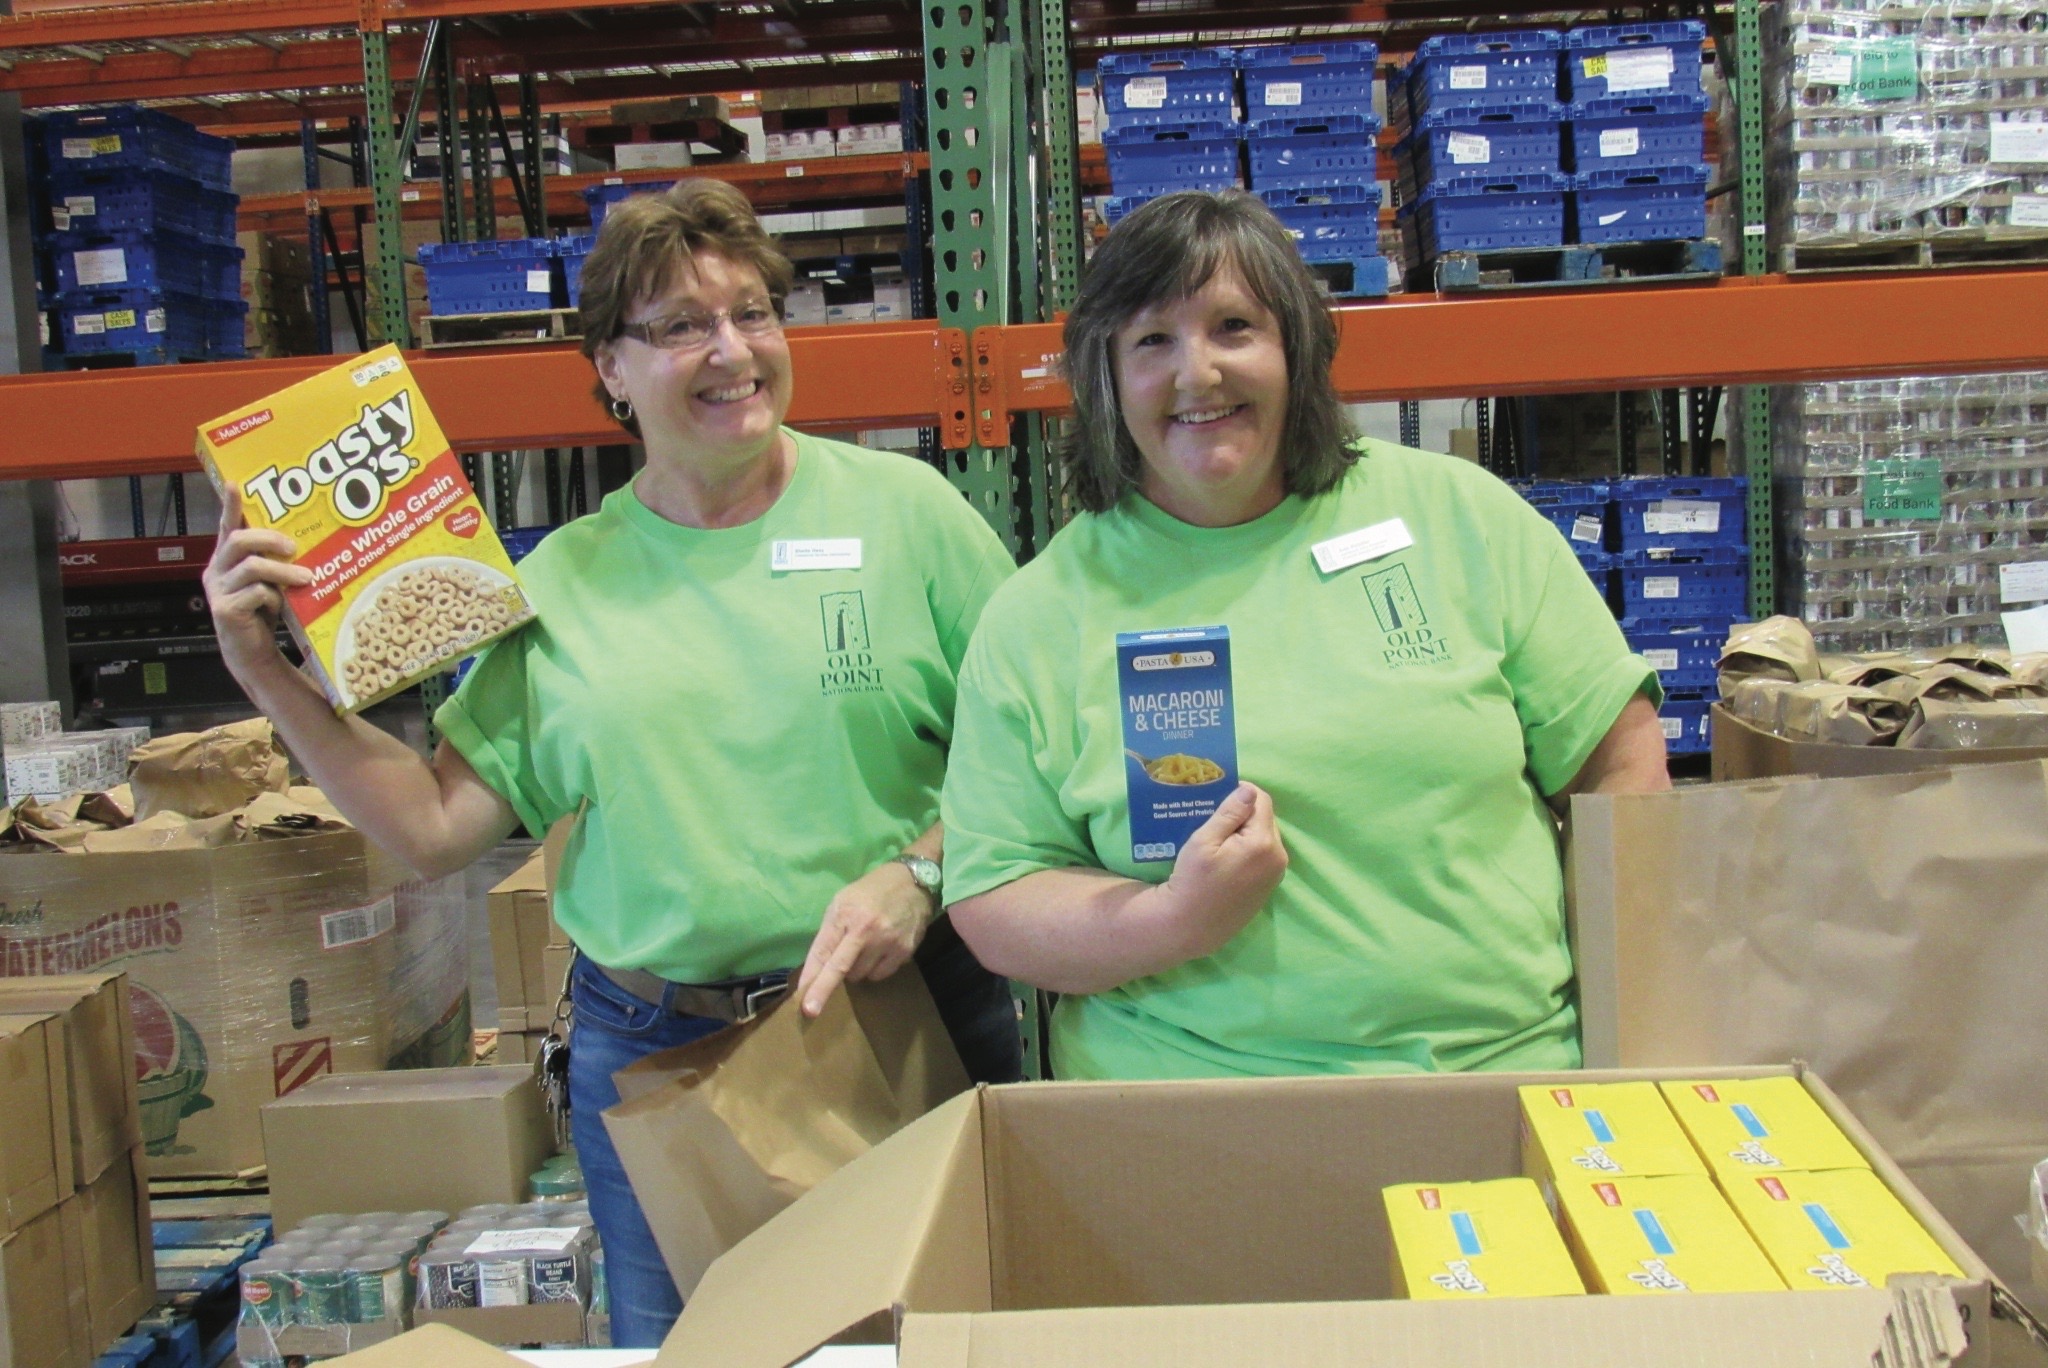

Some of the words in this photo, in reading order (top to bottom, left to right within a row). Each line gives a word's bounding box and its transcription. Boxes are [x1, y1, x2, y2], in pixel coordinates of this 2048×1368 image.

[1878, 76, 1912, 89] Bank
[244, 388, 415, 524] Toasty
[333, 443, 412, 522] O's
[1869, 498, 1899, 510] Food
[1903, 499, 1934, 510] Bank
[452, 511, 473, 525] Heart
[452, 517, 479, 533] Healthy
[294, 520, 324, 538] Cereal
[310, 548, 353, 588] More
[352, 509, 408, 553] Whole
[406, 474, 454, 514] Grain
[311, 578, 340, 601] Than
[338, 562, 359, 584] Any
[357, 541, 387, 568] Other
[386, 522, 417, 549] Single
[415, 487, 464, 527] Ingredient
[1387, 628, 1433, 648] OLD
[1383, 637, 1448, 664] POINT
[828, 653, 873, 669] OLD
[1140, 658, 1169, 668] PASTA
[1184, 655, 1205, 664] USA
[1388, 660, 1427, 671] NATIONAL
[1430, 655, 1453, 665] BANK
[820, 668, 884, 689] POINT
[822, 685, 861, 697] NATIONAL
[865, 685, 885, 693] BANK
[1129, 689, 1224, 713] MACARONI
[1135, 713, 1149, 732] &
[1153, 708, 1221, 731] CHEESE
[1162, 729, 1194, 740] DINNER
[553, 1259, 572, 1268] TURTLE
[546, 1268, 563, 1277] BEANS
